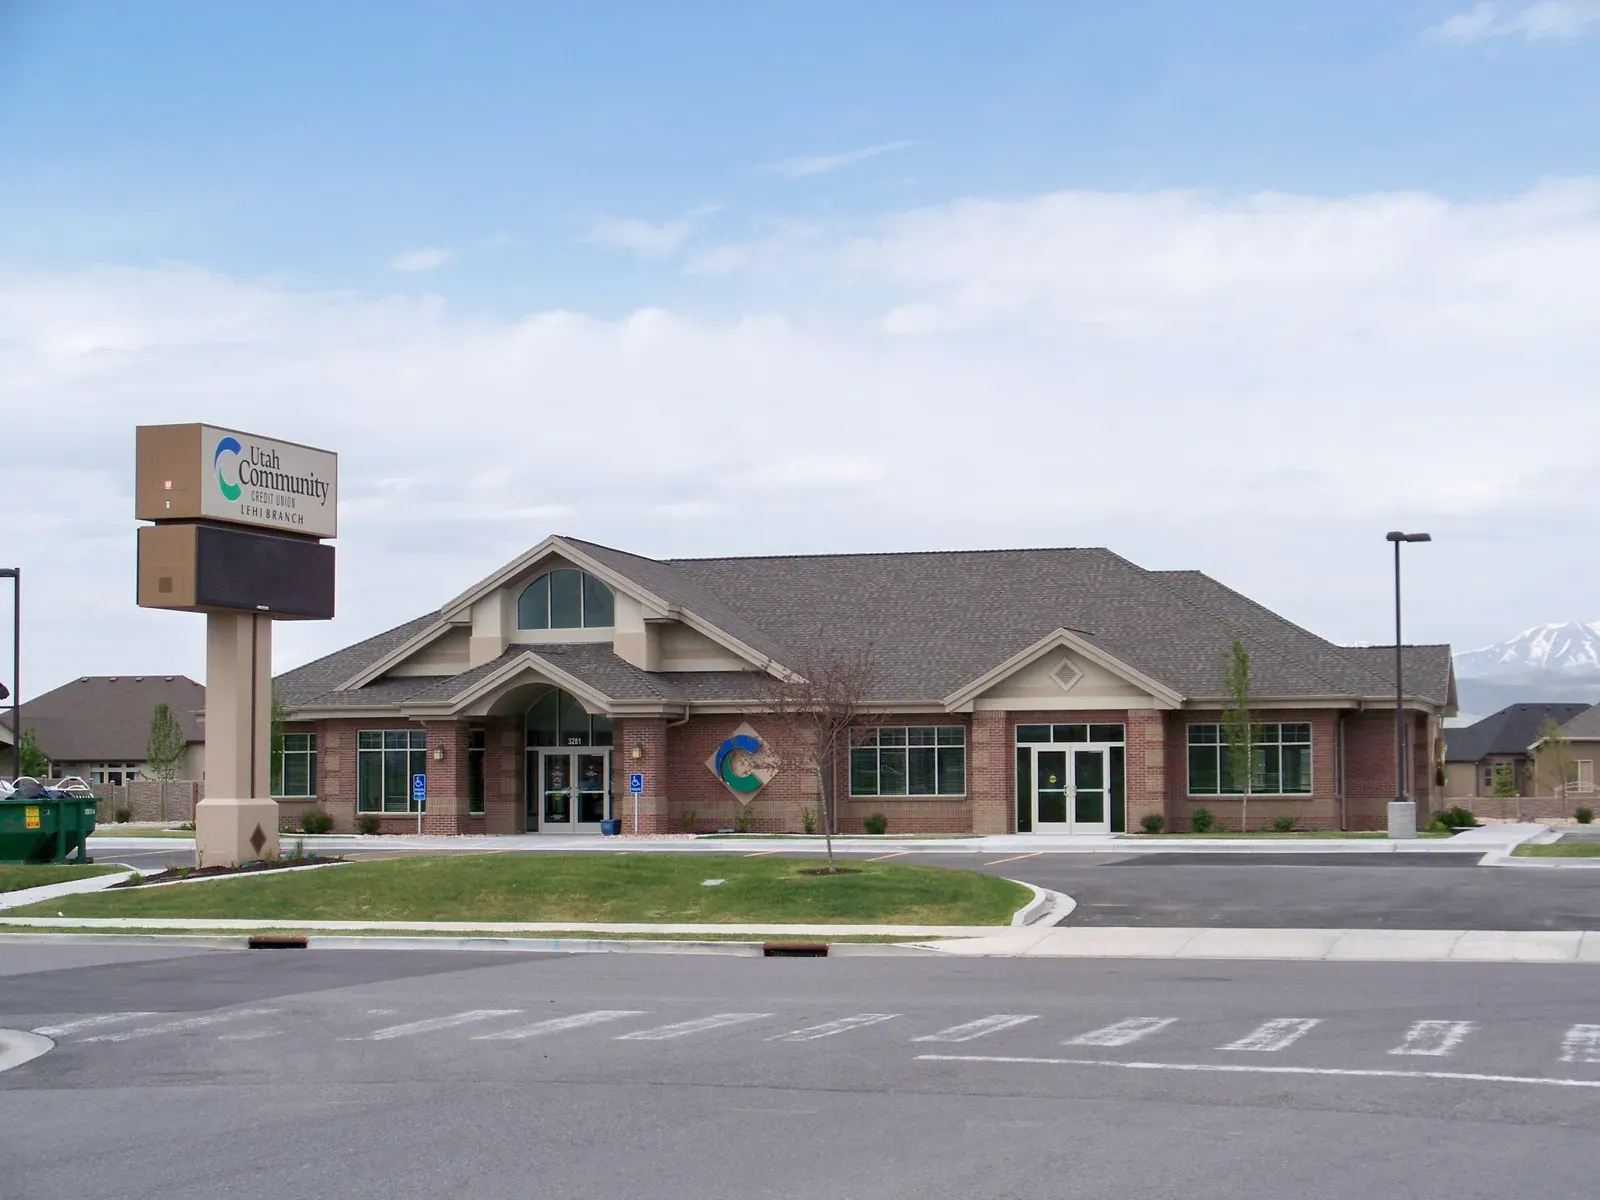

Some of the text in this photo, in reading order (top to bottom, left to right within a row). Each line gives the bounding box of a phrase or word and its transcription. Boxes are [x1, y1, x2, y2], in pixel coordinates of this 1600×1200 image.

[250, 446, 280, 470] Utah
[239, 459, 329, 506] Community
[251, 490, 296, 509] CREDIT UNION
[241, 504, 304, 525] LEHI BRANCH
